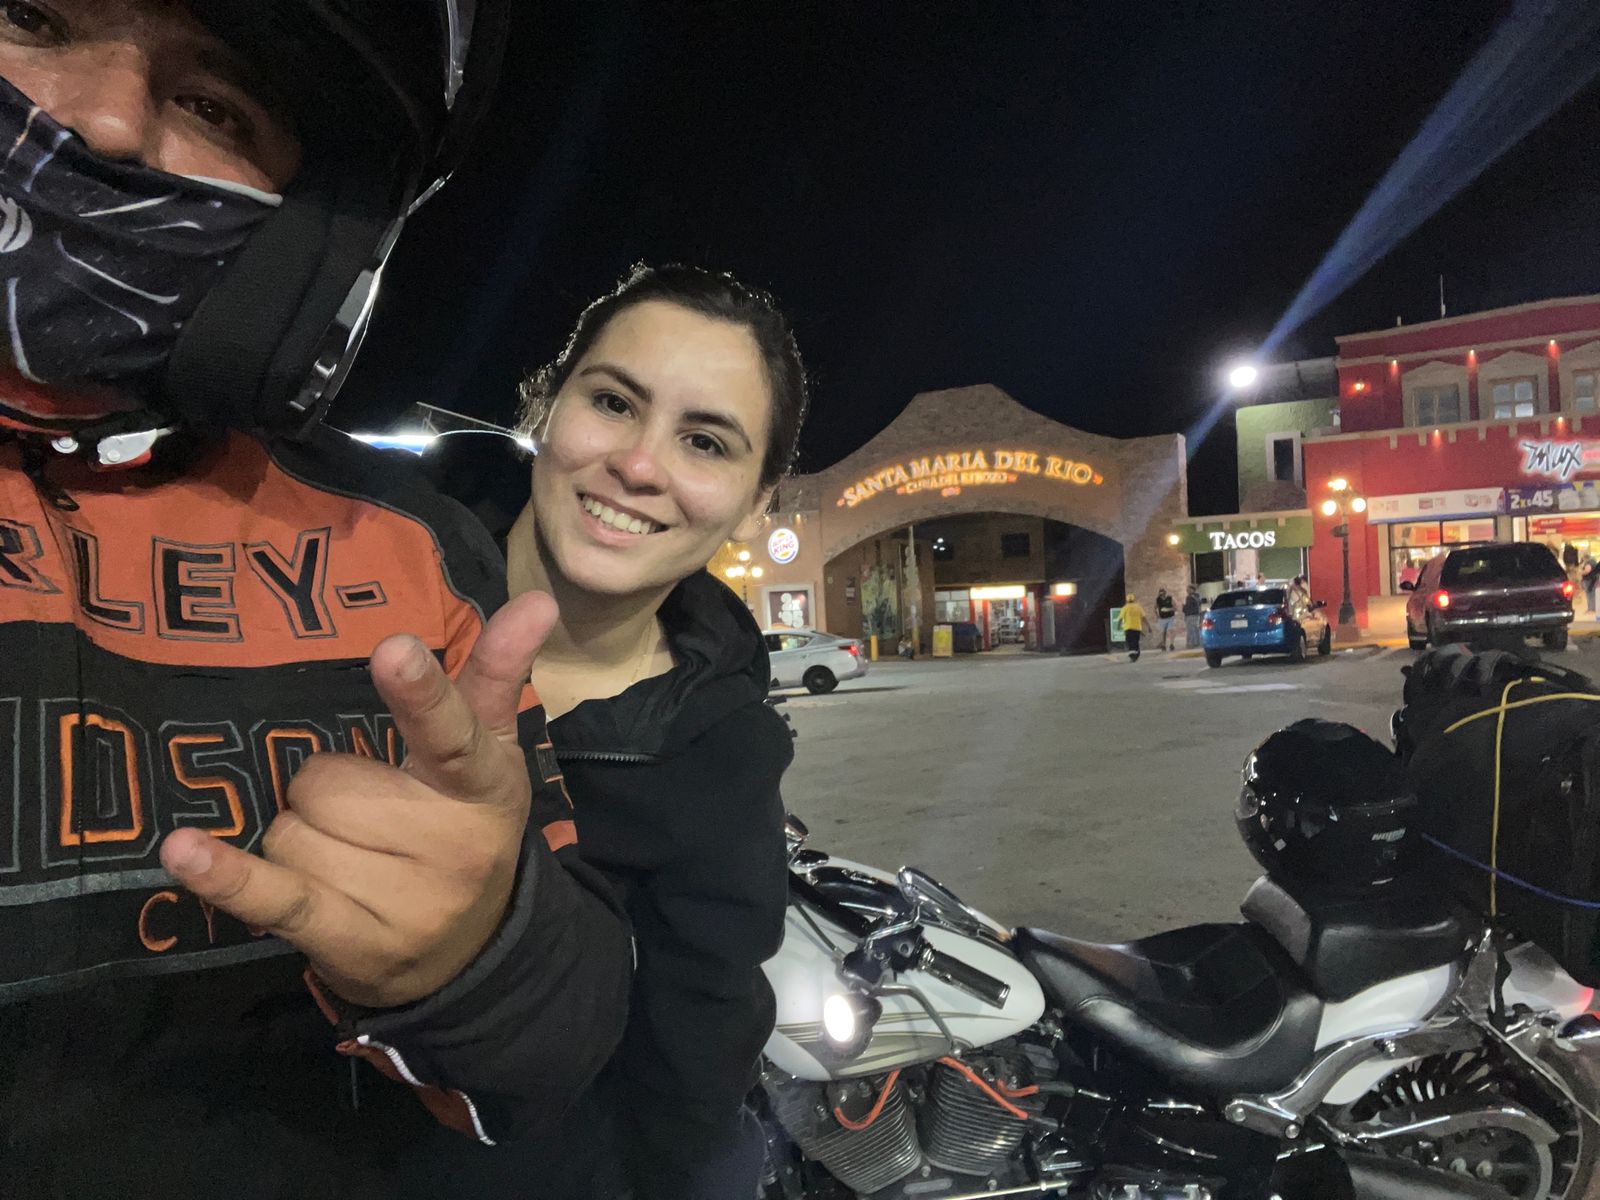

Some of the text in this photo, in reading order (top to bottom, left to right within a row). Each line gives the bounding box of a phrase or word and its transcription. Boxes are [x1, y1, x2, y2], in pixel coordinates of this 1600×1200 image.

[843, 449, 1093, 507] SANTA MARIA DEL RIO
[1209, 530, 1276, 551] TACOS
